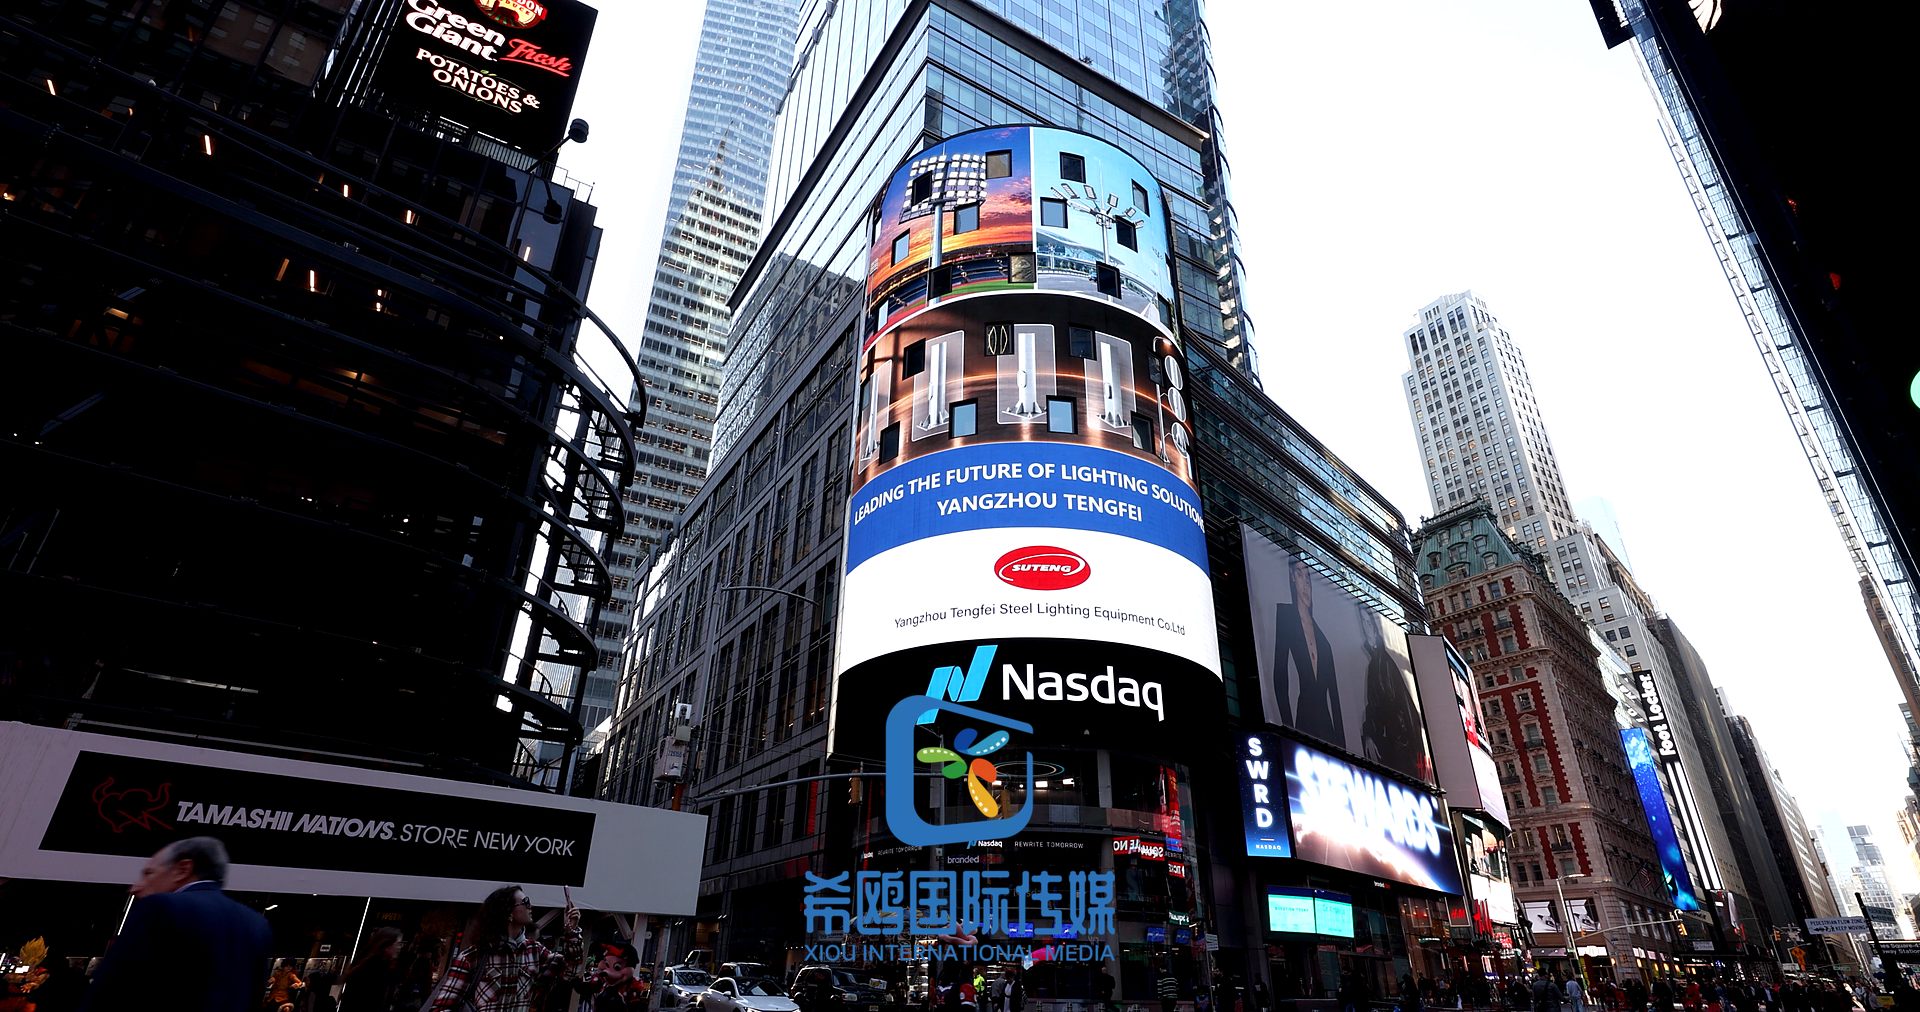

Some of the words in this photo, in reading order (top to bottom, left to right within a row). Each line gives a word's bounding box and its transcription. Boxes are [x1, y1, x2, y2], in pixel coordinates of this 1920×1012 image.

[406, 12, 497, 62] Giant
[408, 0, 506, 47] Green
[509, 38, 573, 71] Fresh
[416, 47, 520, 99] POTATOES
[522, 94, 540, 109] &
[433, 69, 522, 113] ONIONS
[854, 484, 904, 526] LEADING
[908, 472, 940, 495] THE
[946, 463, 1022, 485] FUTURE
[1027, 462, 1055, 479] OF
[1061, 464, 1148, 495] LIGHTING
[936, 492, 1057, 516] YANGZHOU
[1063, 493, 1142, 522] TENGFEI
[1011, 563, 1072, 573] SUTENG
[894, 611, 947, 628] Yangzhou
[950, 603, 996, 619] Tengfei
[999, 602, 1033, 615] Steel
[1037, 602, 1090, 619] Lighting
[1094, 606, 1155, 626] Equipment
[1157, 617, 1186, 636] Co.Ltd
[1002, 663, 1164, 721] Nasdaq
[1639, 673, 1665, 721] Locker
[1653, 723, 1677, 756] Foot
[176, 800, 294, 831] TAMASHII
[292, 813, 395, 840] NATIONS
[400, 823, 469, 849] STORE
[473, 830, 521, 851] NEW
[524, 835, 576, 857] YORK
[978, 840, 1002, 849] Nasdaq
[1046, 841, 1084, 849] TOMORROW
[947, 855, 980, 864] branded
